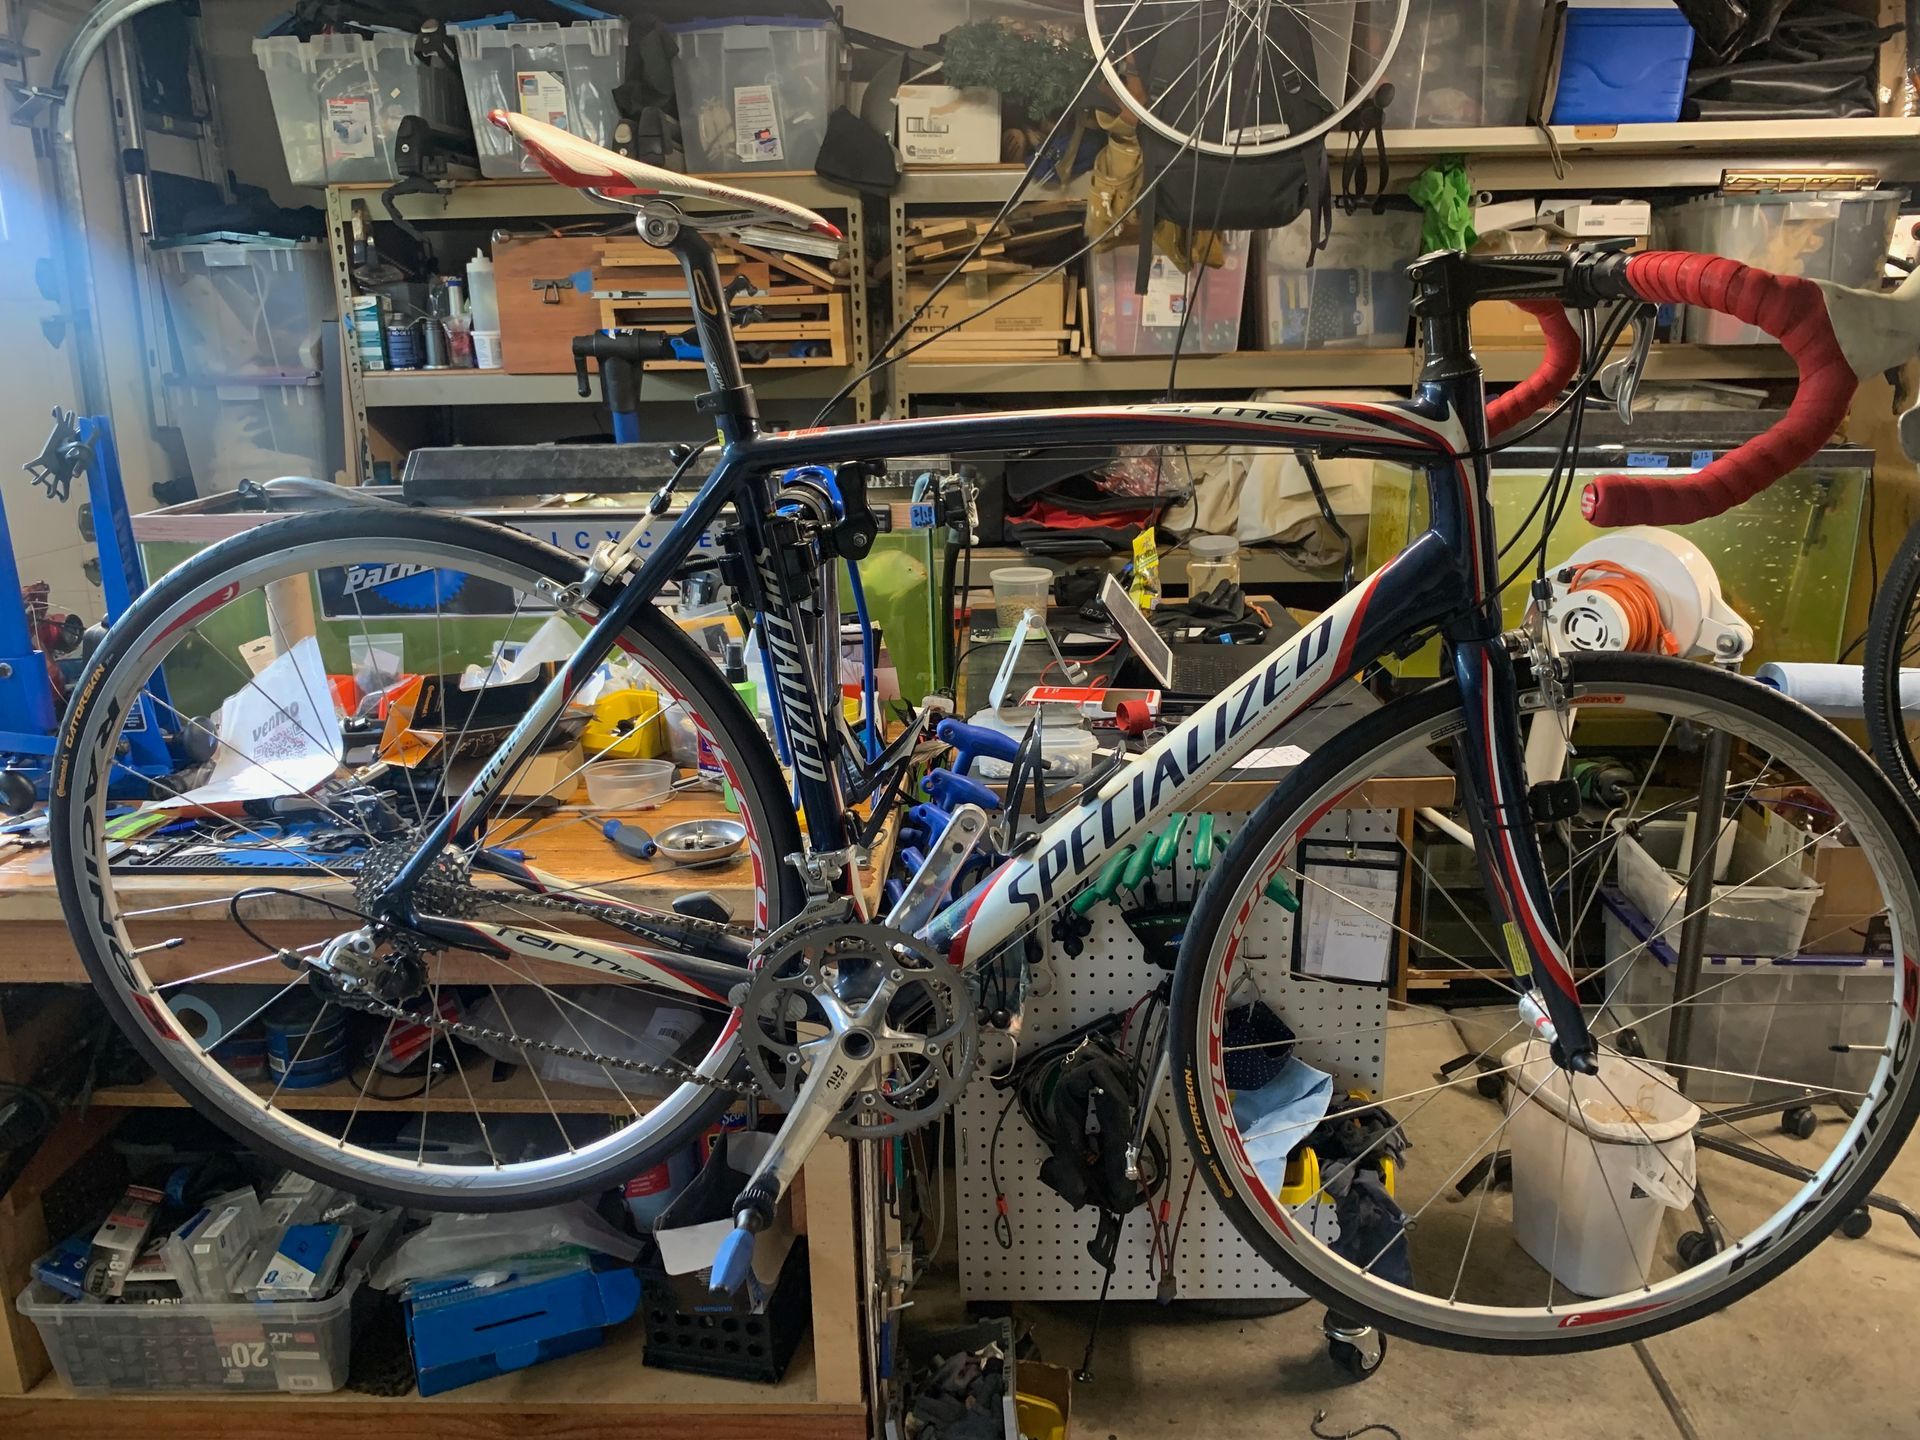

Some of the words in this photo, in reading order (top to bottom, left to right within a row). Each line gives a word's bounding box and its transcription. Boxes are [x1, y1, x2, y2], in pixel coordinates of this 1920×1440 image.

[1491, 253, 1562, 262] SPECIALIZED
[913, 304, 950, 319] ST-7
[65, 663, 106, 749] GATORSKIN
[252, 701, 299, 742] venmo
[1007, 614, 1334, 917] SPECIALIZED
[82, 696, 140, 990] RACING
[1210, 832, 1298, 1178] FULCRUM
[1184, 1068, 1211, 1155] GATORSKIN
[1727, 1019, 1912, 1276] RACING
[90, 1268, 108, 1296] BELL
[220, 1341, 269, 1368] 20"
[269, 1331, 293, 1344] 27"
